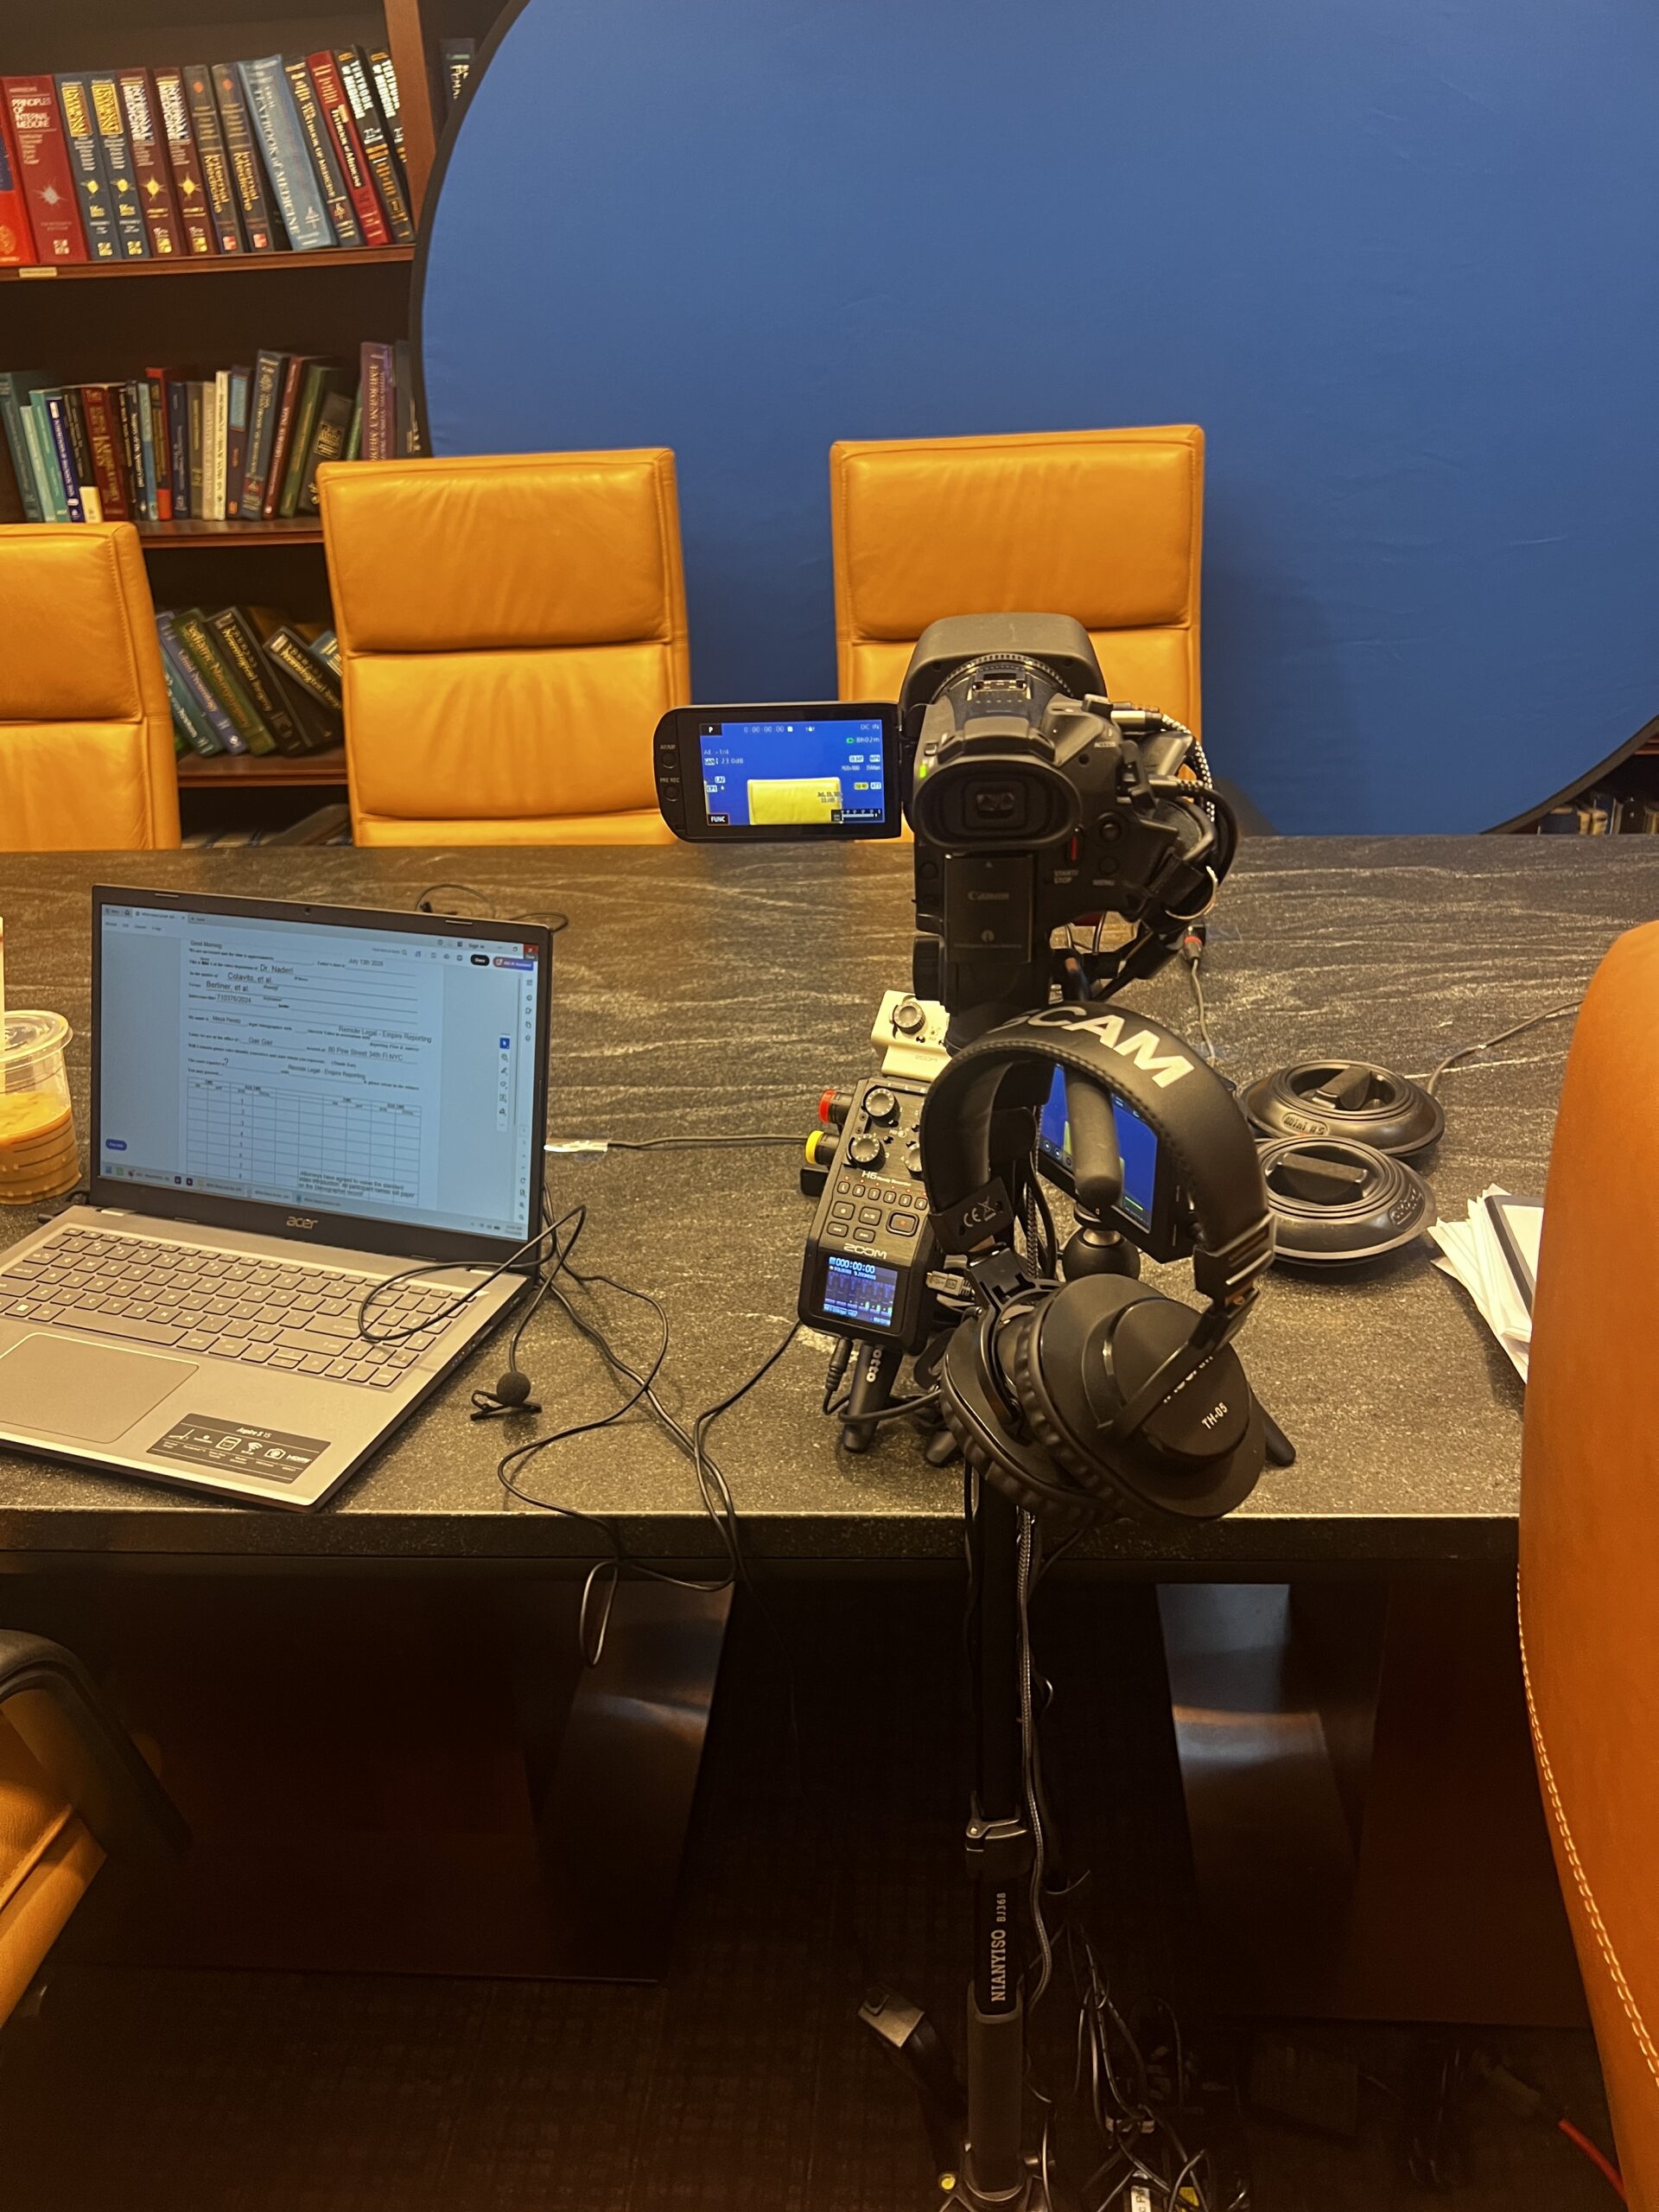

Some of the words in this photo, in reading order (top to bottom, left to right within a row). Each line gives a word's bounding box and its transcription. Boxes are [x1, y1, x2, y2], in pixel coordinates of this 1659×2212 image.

[11, 97, 52, 107] PRINCIPLES
[343, 75, 366, 120] MEDICINE
[350, 60, 374, 111] TEXTBOOK
[374, 74, 397, 118] MEDICINE
[13, 106, 24, 115] OF
[16, 119, 50, 129] MEDICINE
[204, 155, 222, 213] Medicine
[210, 154, 230, 203] Internal
[233, 152, 252, 211] Medicine
[238, 151, 259, 200] Internal
[253, 90, 279, 158] TEXTBOOK
[276, 172, 301, 235] MEDICINE
[369, 365, 379, 429] EMERGENCY
[222, 628, 256, 682] Neurological
[280, 650, 326, 693] Neurological
[967, 892, 1010, 900] Canon
[404, 1033, 432, 1044] Reporting
[861, 1170, 878, 1180] H6
[286, 1217, 319, 1230] acer
[836, 1257, 875, 1274] 000:00:00
[843, 1243, 887, 1260] ZOOM
[867, 1344, 883, 1382] otto
[1202, 1402, 1228, 1429] TH-05
[990, 1929, 1007, 2002] NIANYISO
